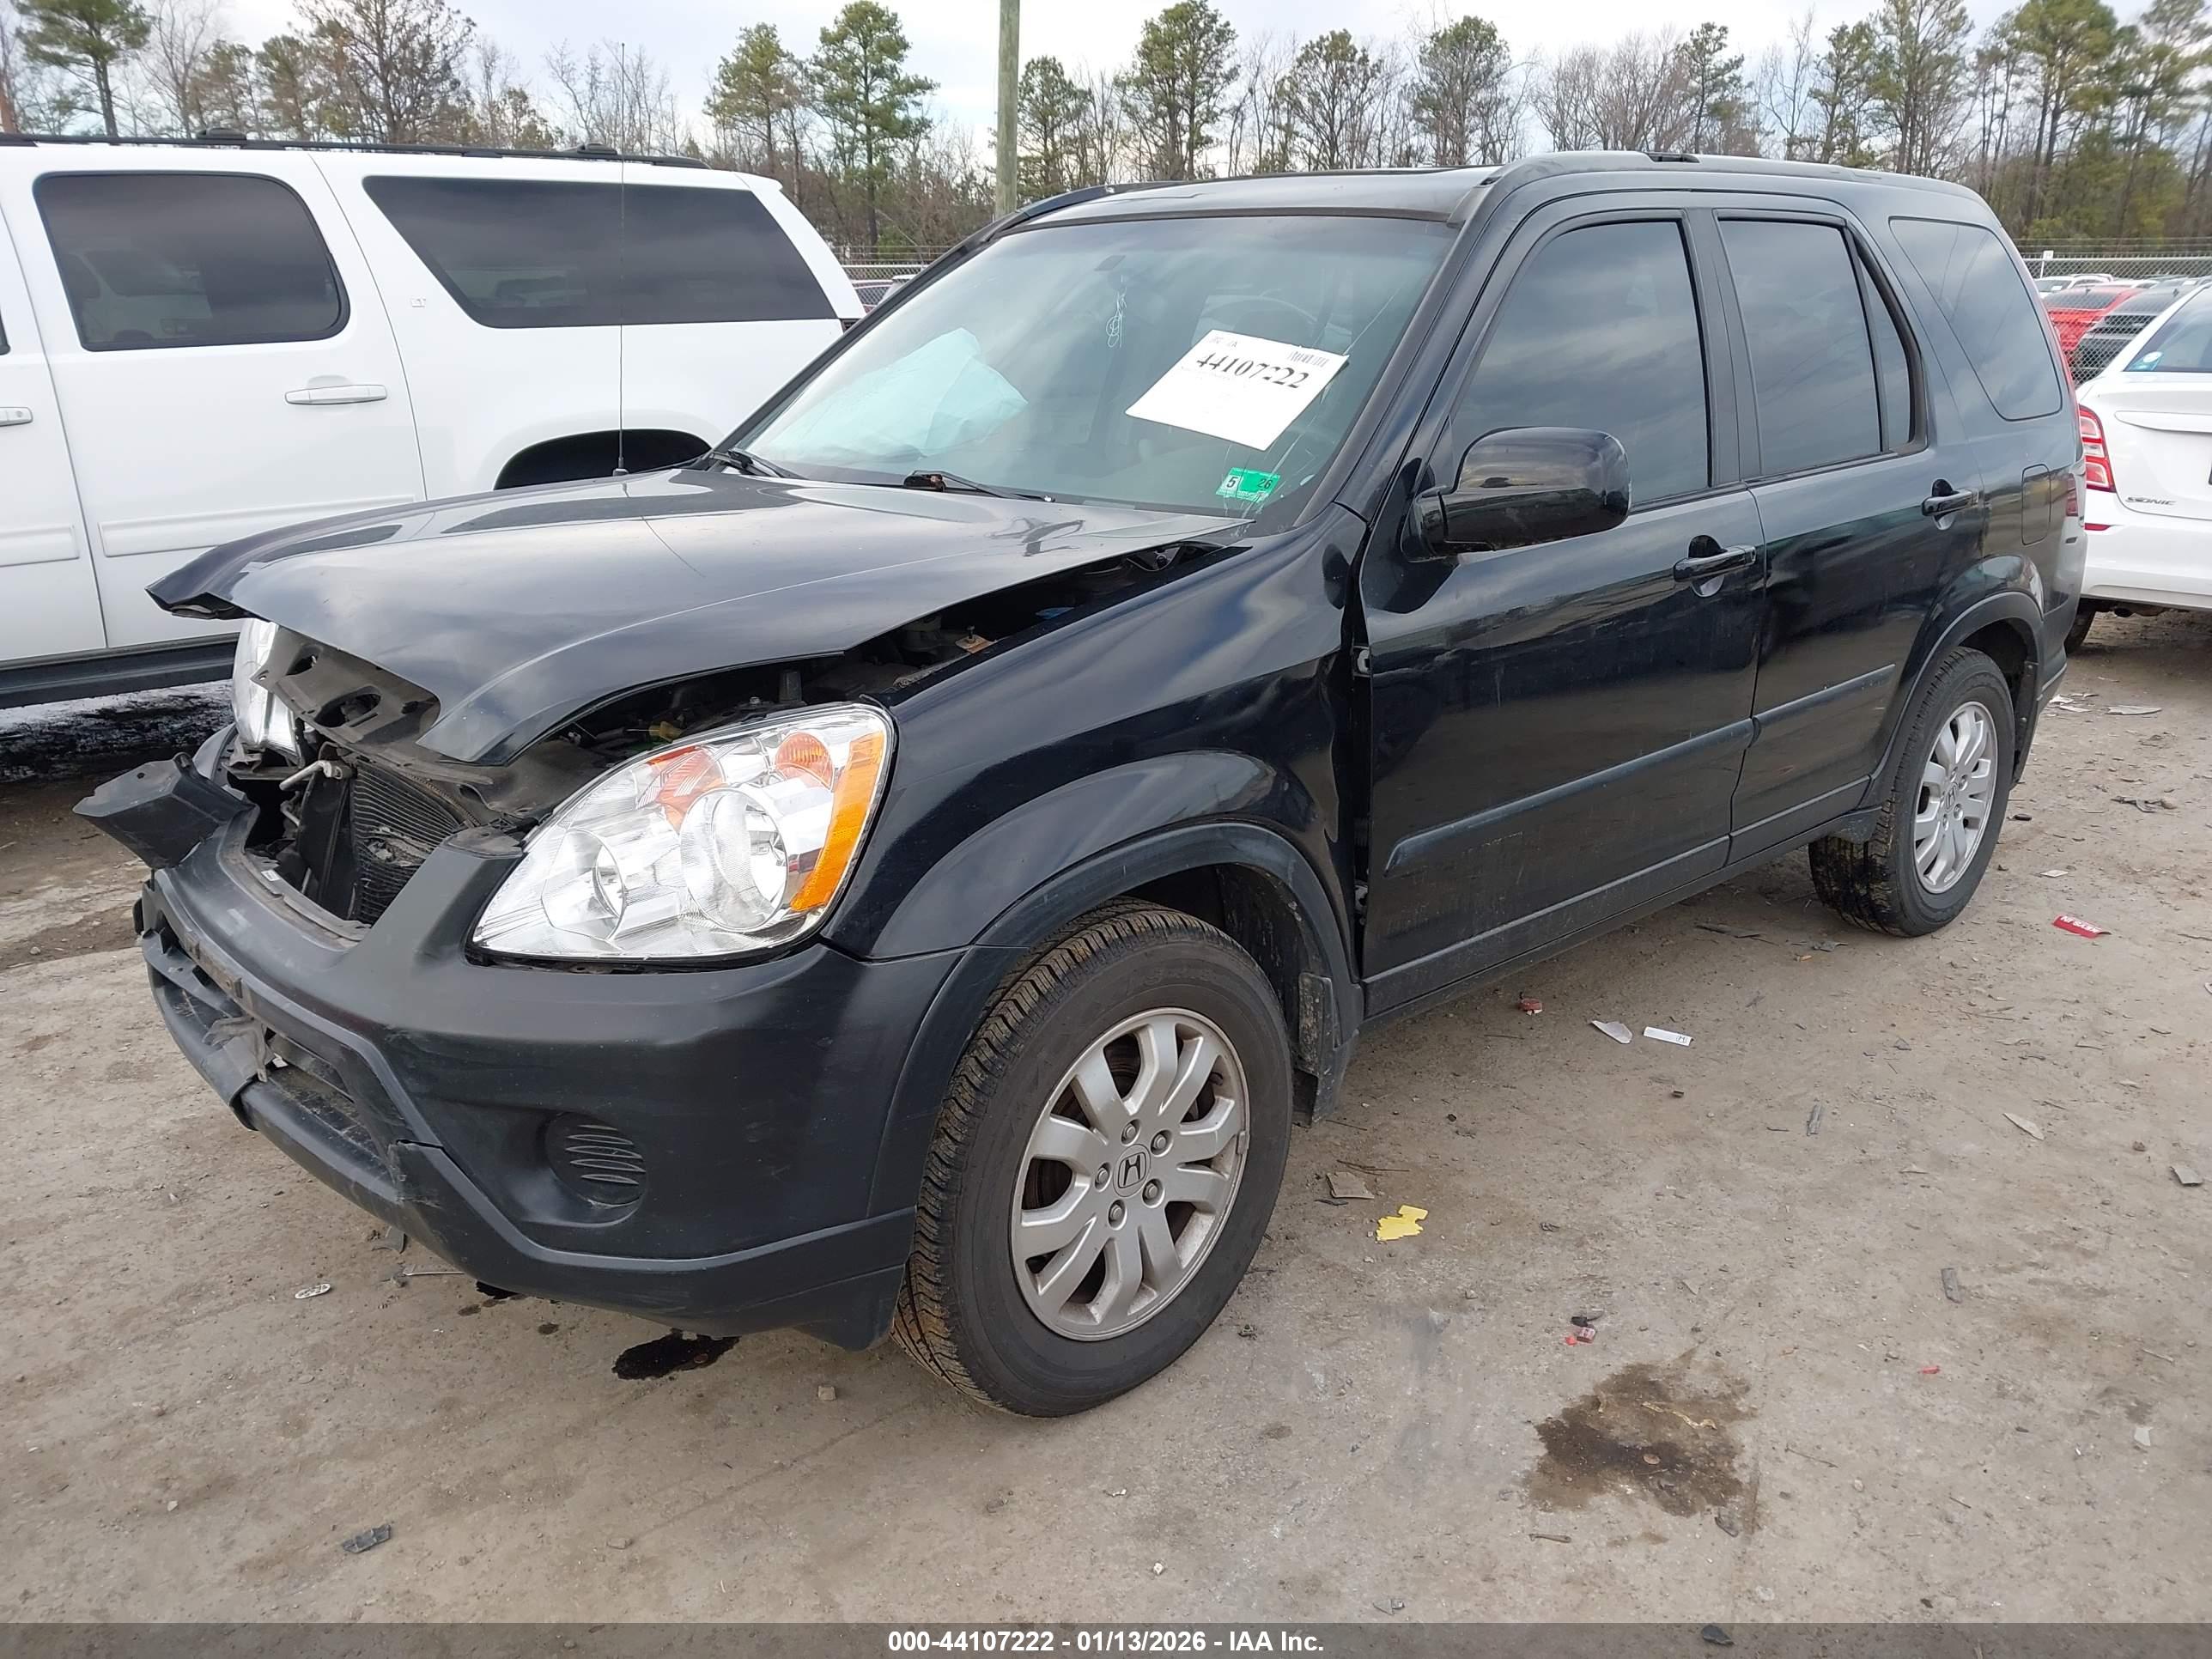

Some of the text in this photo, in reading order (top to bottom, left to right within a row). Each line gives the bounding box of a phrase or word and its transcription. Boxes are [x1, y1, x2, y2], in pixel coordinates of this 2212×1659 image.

[1196, 352, 1310, 389] 44107222
[1226, 476, 1273, 489] 5 26
[2125, 496, 2177, 506] SONIC
